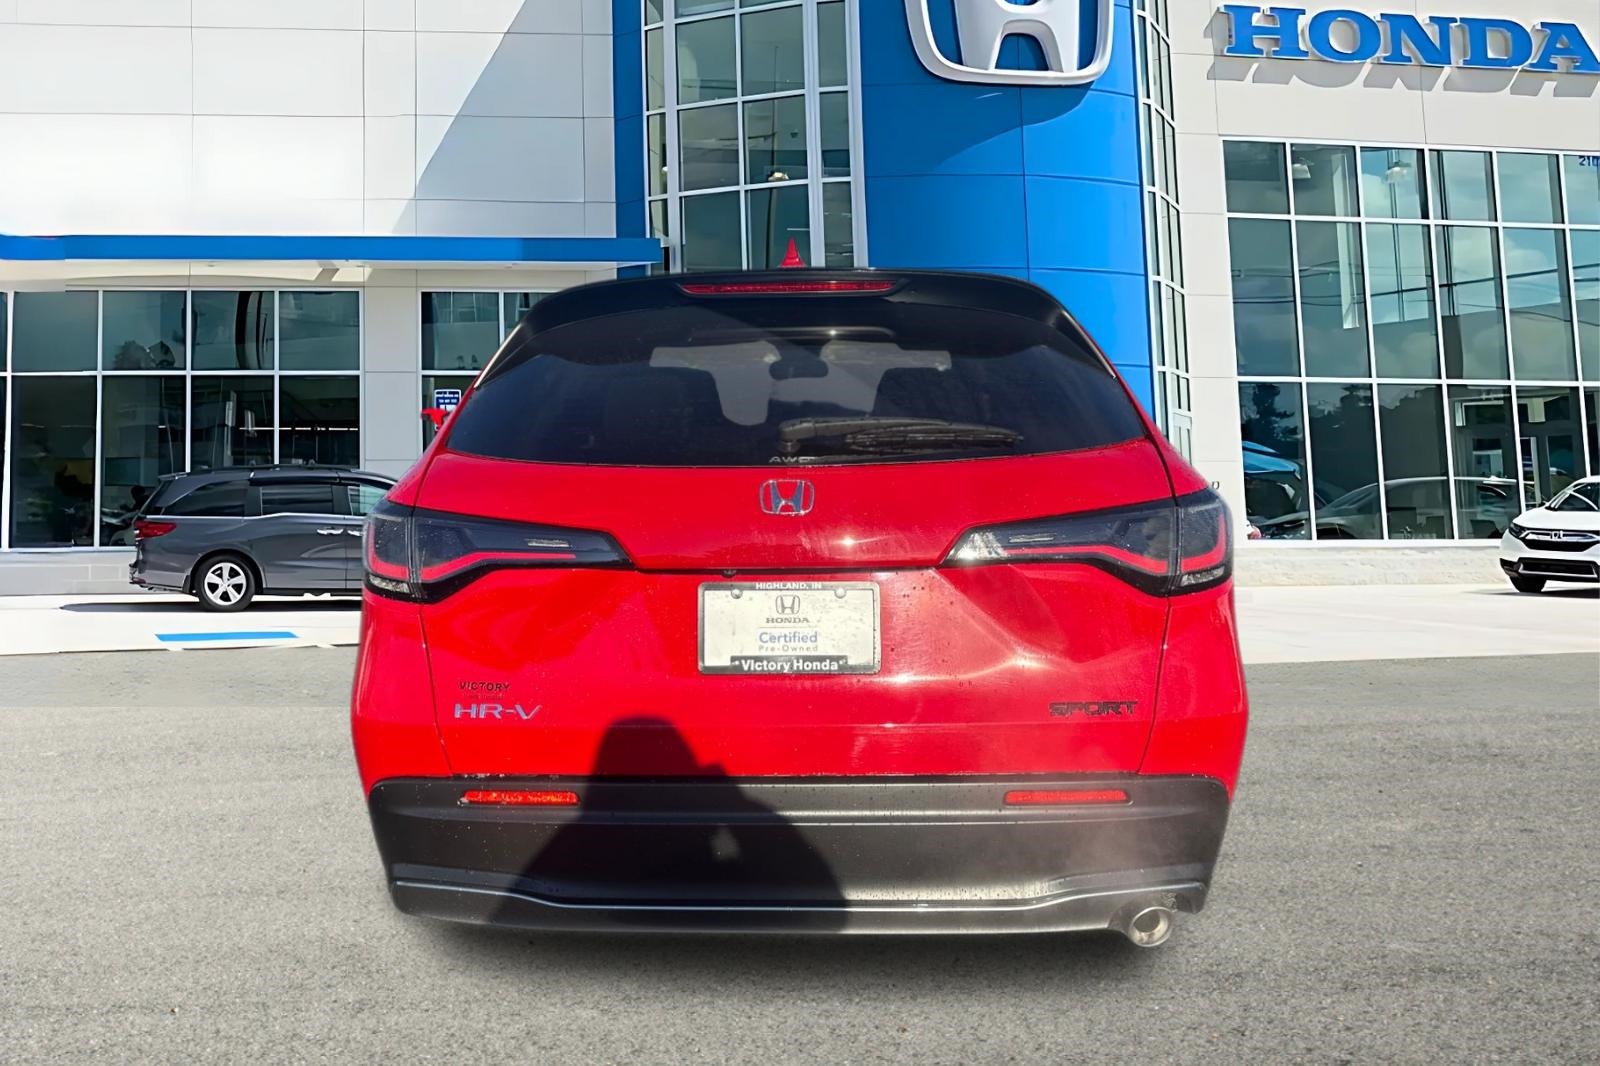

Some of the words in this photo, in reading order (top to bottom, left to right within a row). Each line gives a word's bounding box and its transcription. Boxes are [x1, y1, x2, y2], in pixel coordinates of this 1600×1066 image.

[1222, 4, 1600, 73] HONDA
[811, 582, 822, 590] IN
[759, 631, 818, 644] Certified
[758, 645, 819, 653] Pre-Owned
[741, 659, 790, 673] Victory
[793, 659, 839, 671] Honda
[459, 681, 510, 692] VICTORY
[454, 703, 543, 720] HR-V
[1048, 700, 1138, 717] SPORT
